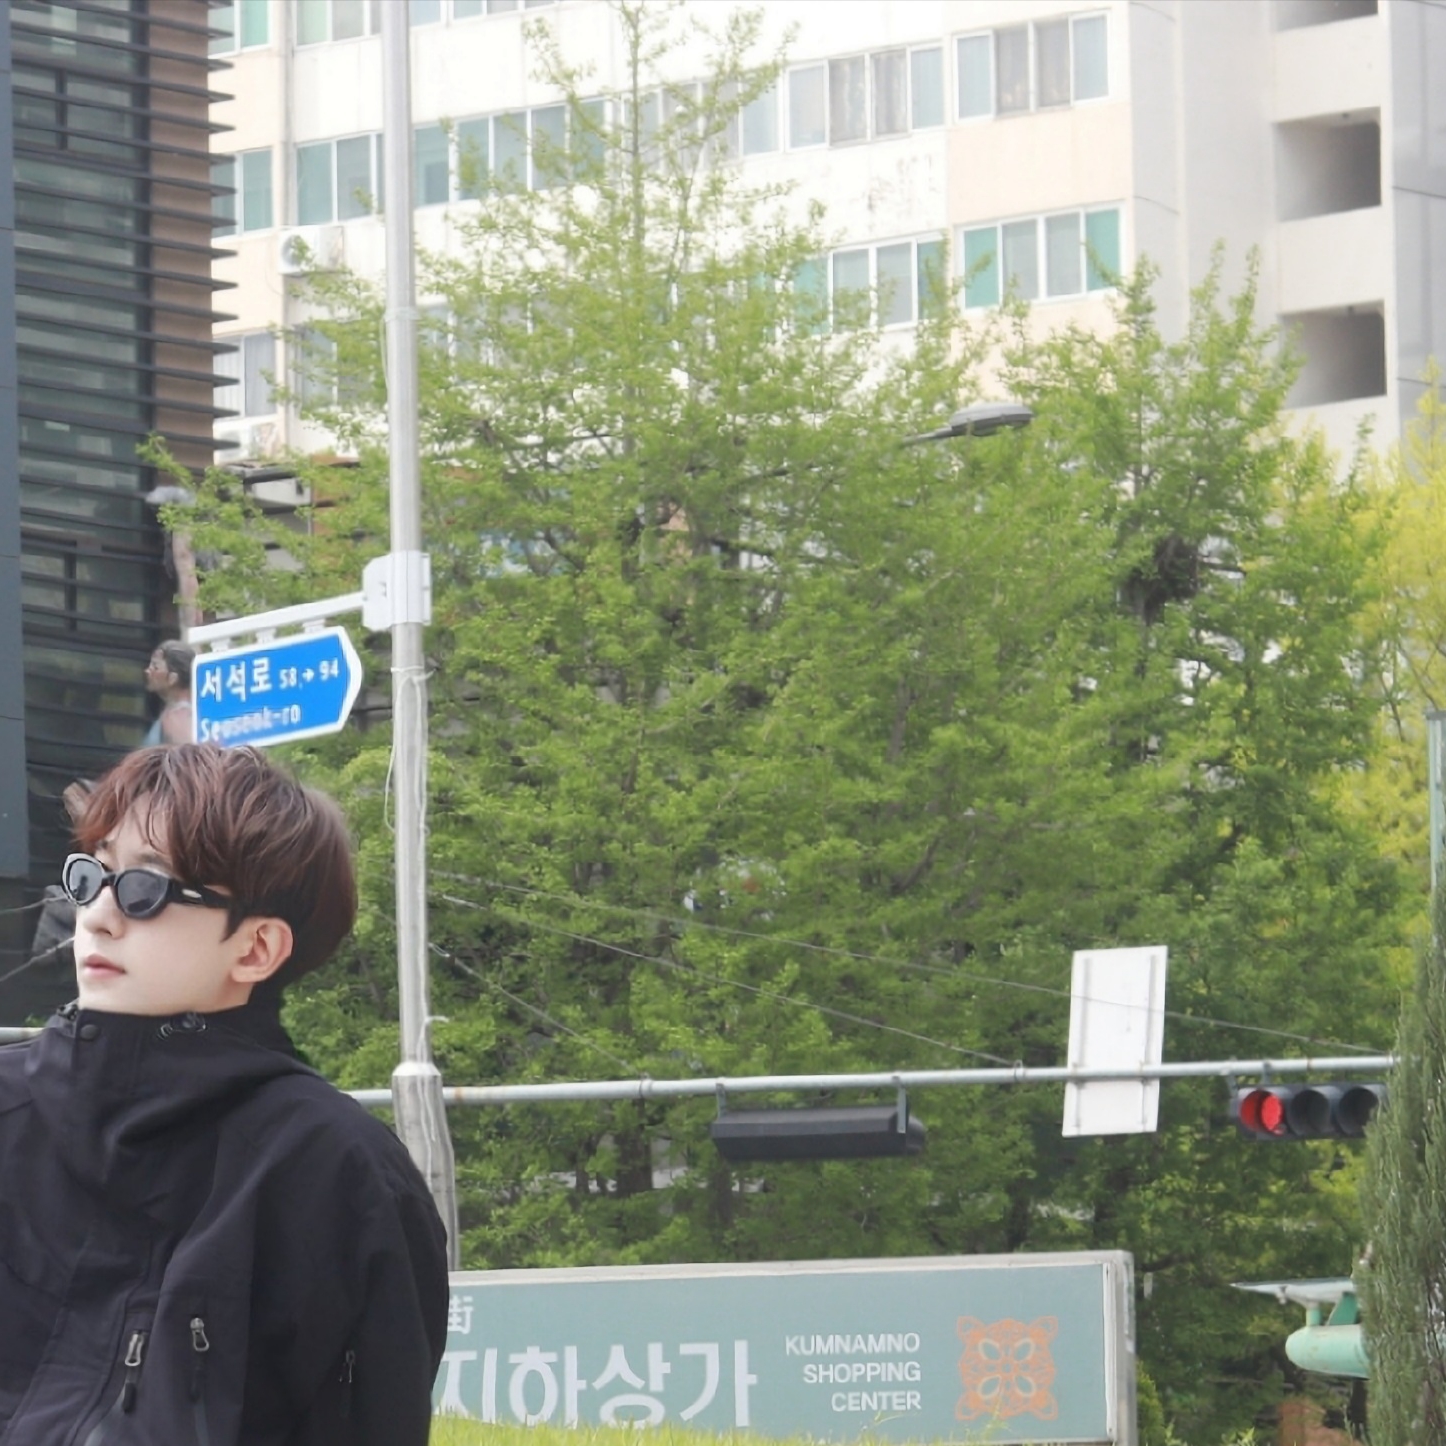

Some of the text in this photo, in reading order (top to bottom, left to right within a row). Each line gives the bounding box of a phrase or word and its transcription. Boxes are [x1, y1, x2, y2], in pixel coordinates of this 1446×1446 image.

[200, 657, 272, 702] 서석로
[319, 657, 340, 681] 94
[785, 1332, 921, 1356] KUMNAMNO
[434, 1339, 758, 1430] 지하상가
[803, 1361, 921, 1384] SHOPPING
[831, 1390, 922, 1412] CENTER
